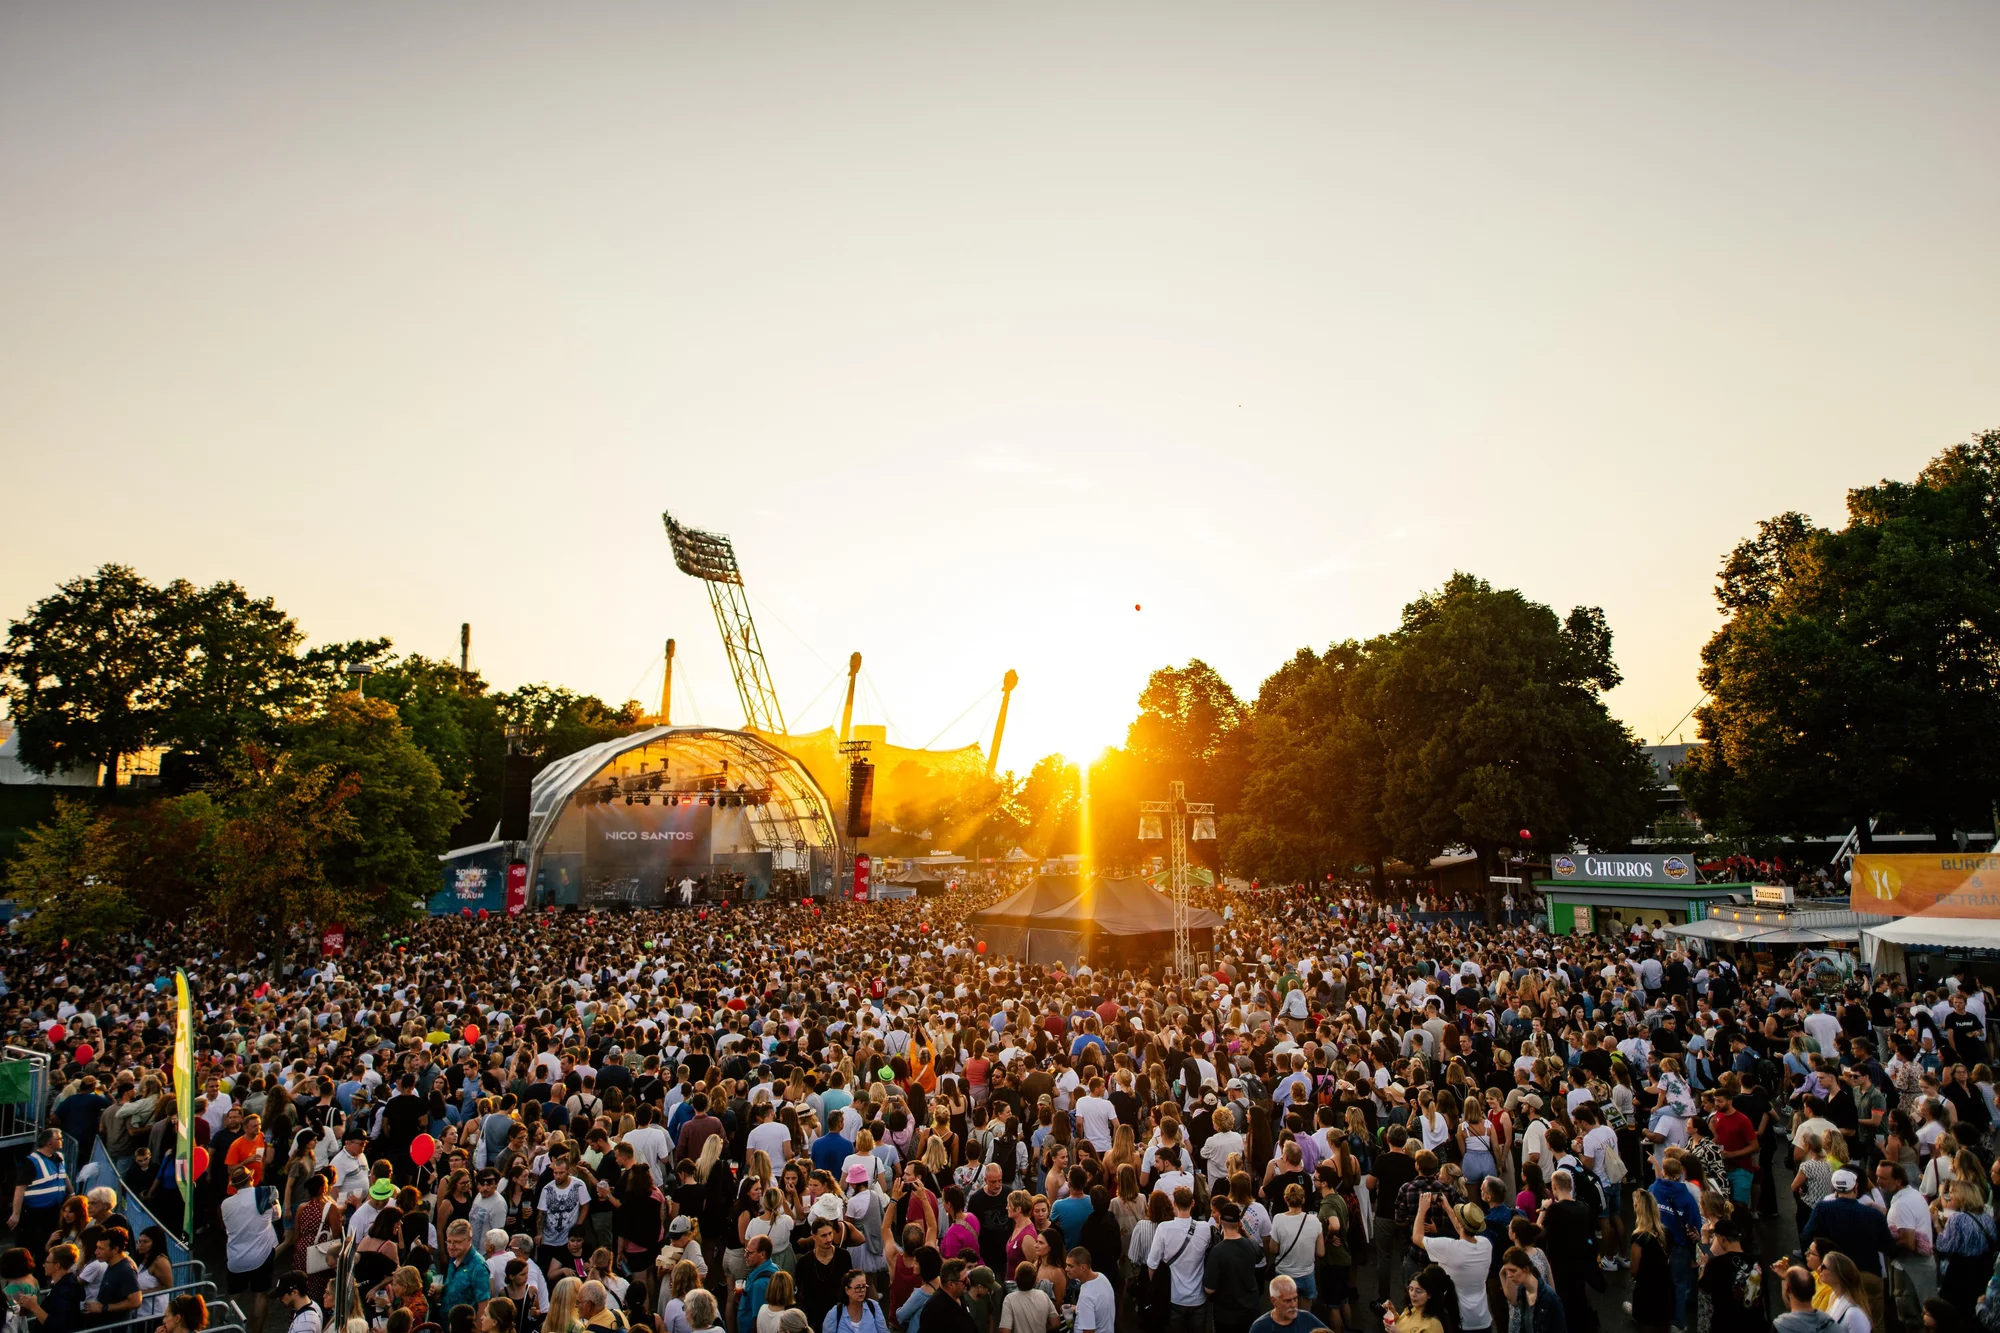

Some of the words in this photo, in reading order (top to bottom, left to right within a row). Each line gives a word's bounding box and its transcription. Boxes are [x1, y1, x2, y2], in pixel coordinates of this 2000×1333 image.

[605, 831, 637, 840] NICO
[640, 831, 694, 840] SANTOS
[455, 868, 488, 876] SOMMER
[1585, 857, 1653, 877] CHURROS
[455, 880, 487, 888] NACHTS
[1972, 876, 1983, 888] &
[875, 982, 883, 993] 10
